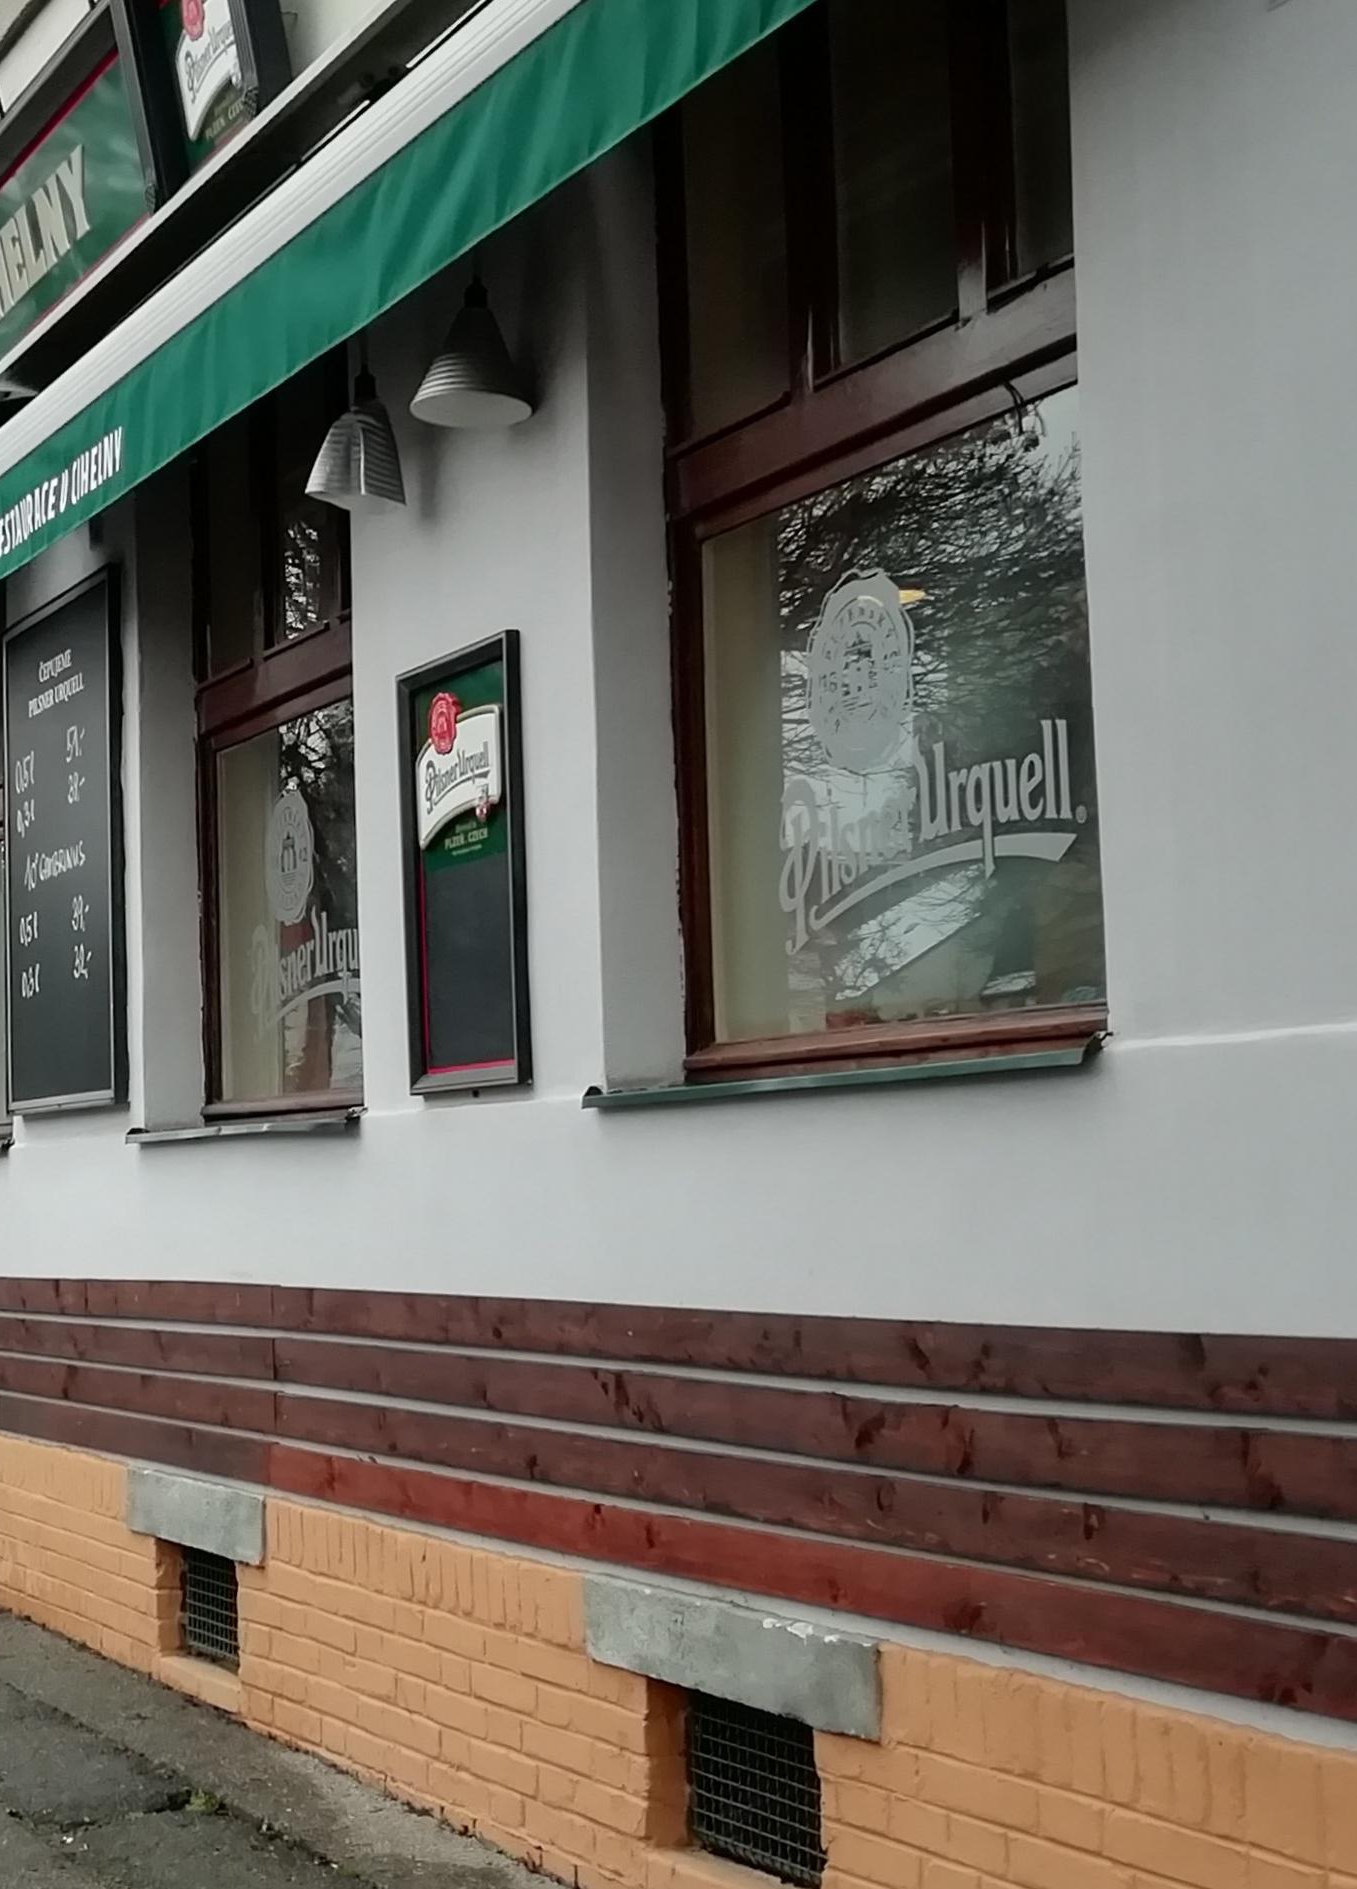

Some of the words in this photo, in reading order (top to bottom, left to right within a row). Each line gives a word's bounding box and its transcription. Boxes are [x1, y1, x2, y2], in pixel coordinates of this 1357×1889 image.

[59, 469, 70, 513] U
[71, 426, 123, 505] CIHELNY
[425, 759, 459, 815] Pilsner
[456, 741, 490, 785] Urquell
[913, 718, 1073, 880] Urquell
[311, 904, 358, 1005] Urqu
